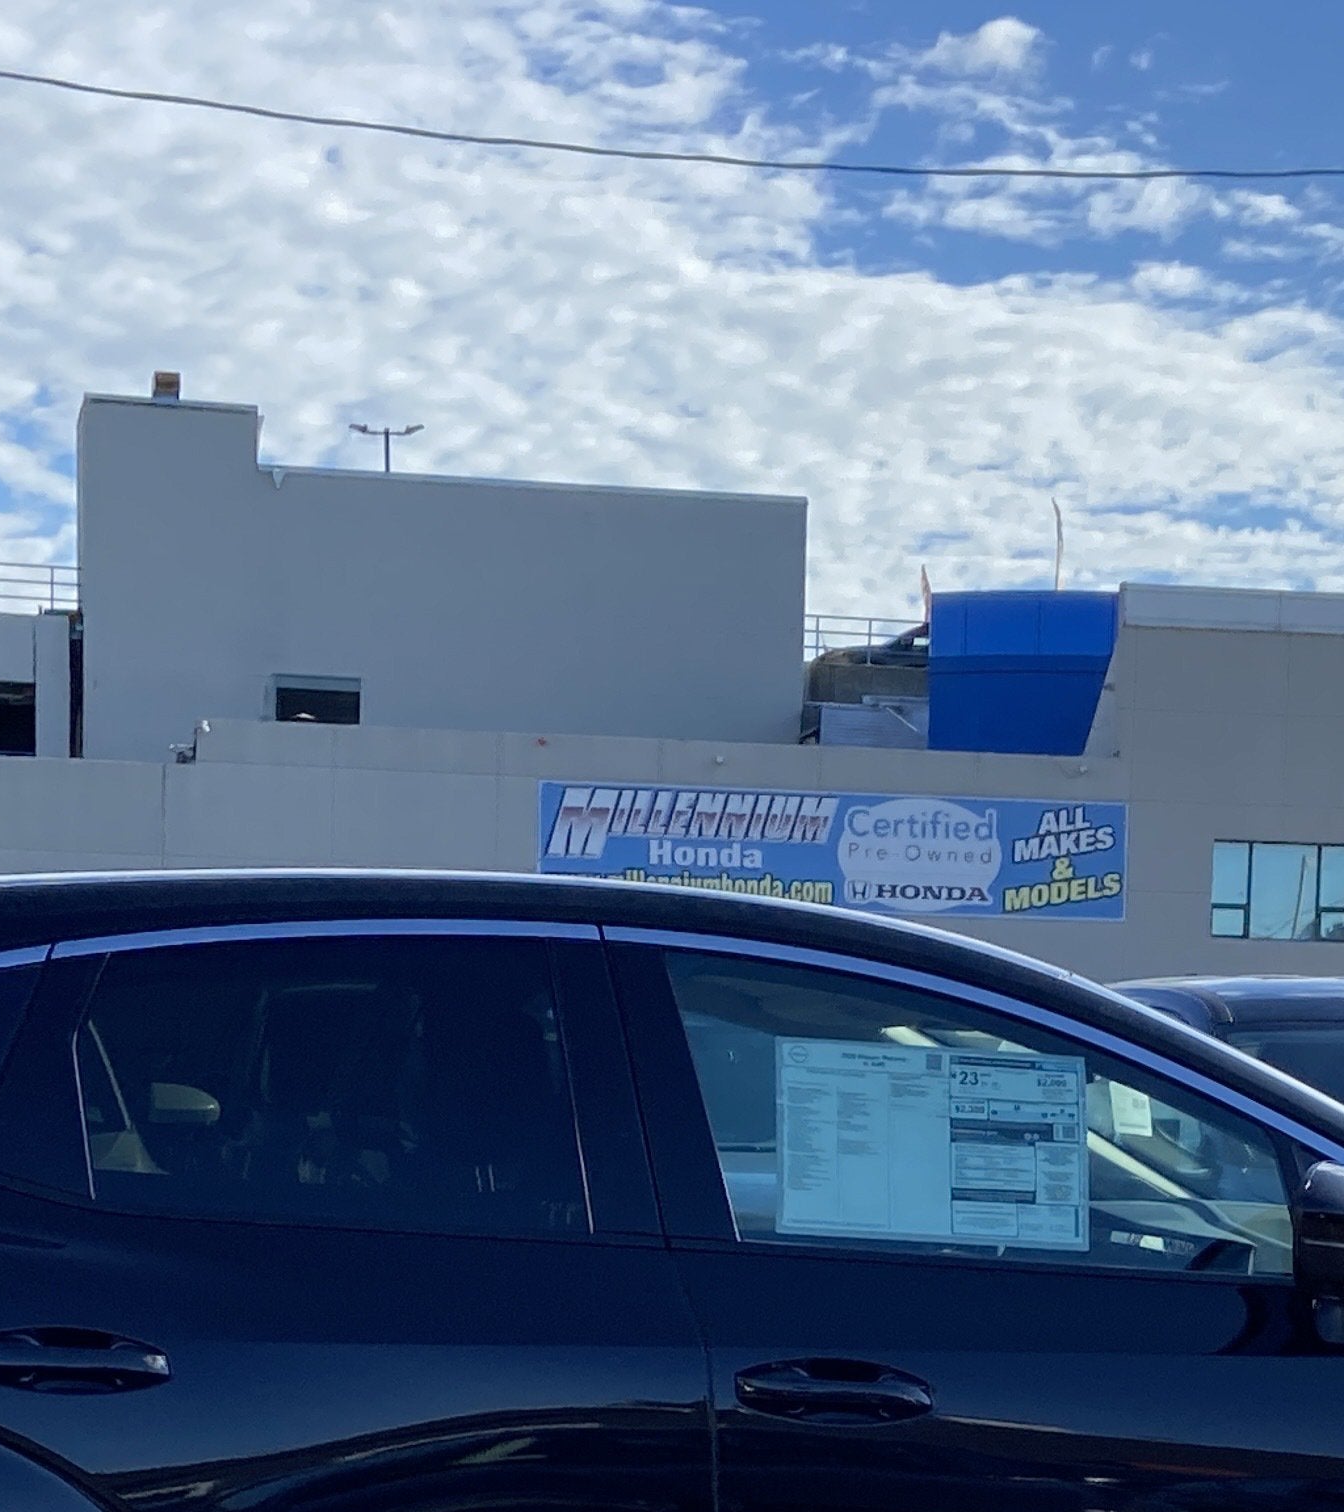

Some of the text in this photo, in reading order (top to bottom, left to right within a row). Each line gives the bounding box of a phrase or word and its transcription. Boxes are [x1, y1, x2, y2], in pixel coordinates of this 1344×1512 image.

[545, 787, 840, 858] MILLENNIUM
[847, 807, 995, 842] Certified
[1036, 808, 1091, 836] ALL
[649, 839, 763, 869] Honda
[848, 842, 994, 865] Pre-Owned
[1012, 826, 1116, 863] MAKES
[1051, 855, 1074, 880] &
[876, 883, 989, 902] HONDA
[1002, 872, 1123, 914] MODELS
[958, 1070, 980, 1086] 23
